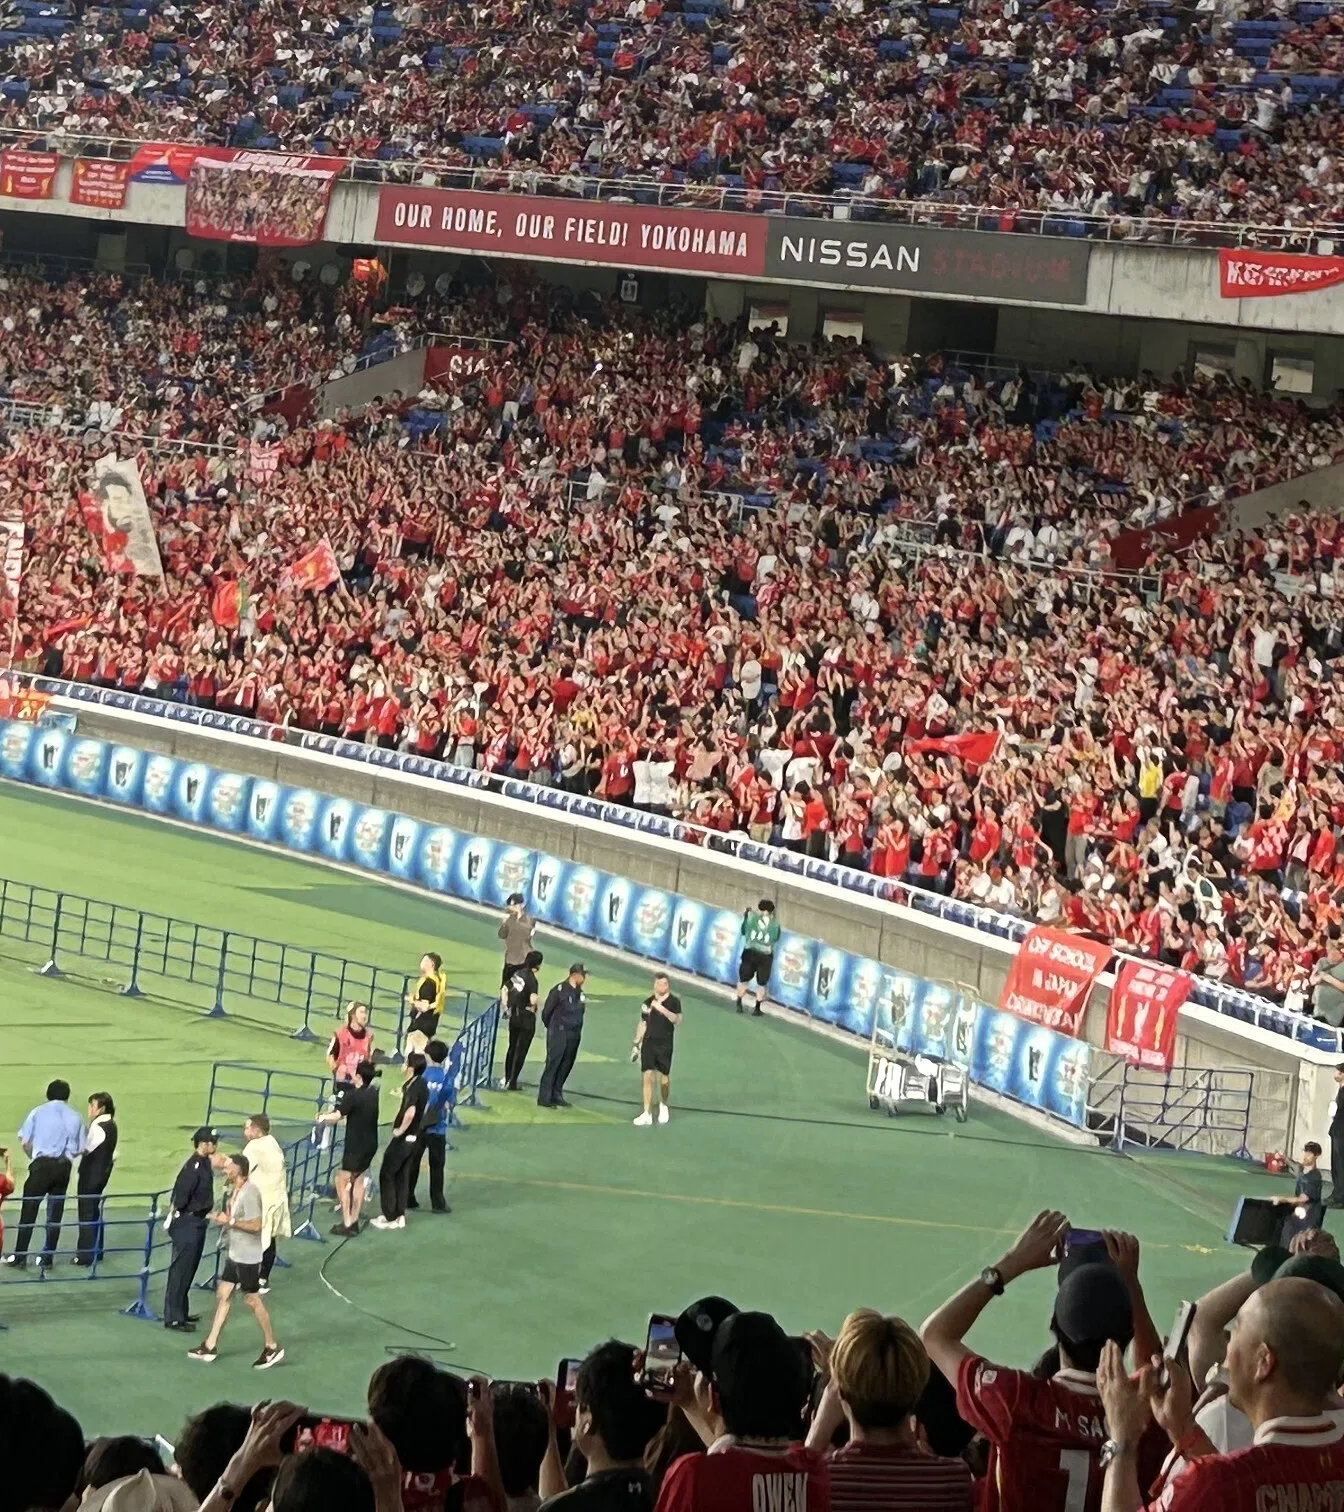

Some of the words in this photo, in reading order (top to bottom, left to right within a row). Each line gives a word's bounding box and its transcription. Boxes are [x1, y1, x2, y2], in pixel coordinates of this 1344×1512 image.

[393, 202, 433, 229] OUR
[441, 206, 503, 239] HOME,
[515, 212, 555, 240] OUR
[564, 217, 629, 247] FIELD!
[640, 224, 748, 257] YOKOHAMA
[779, 235, 921, 274] NISSAN
